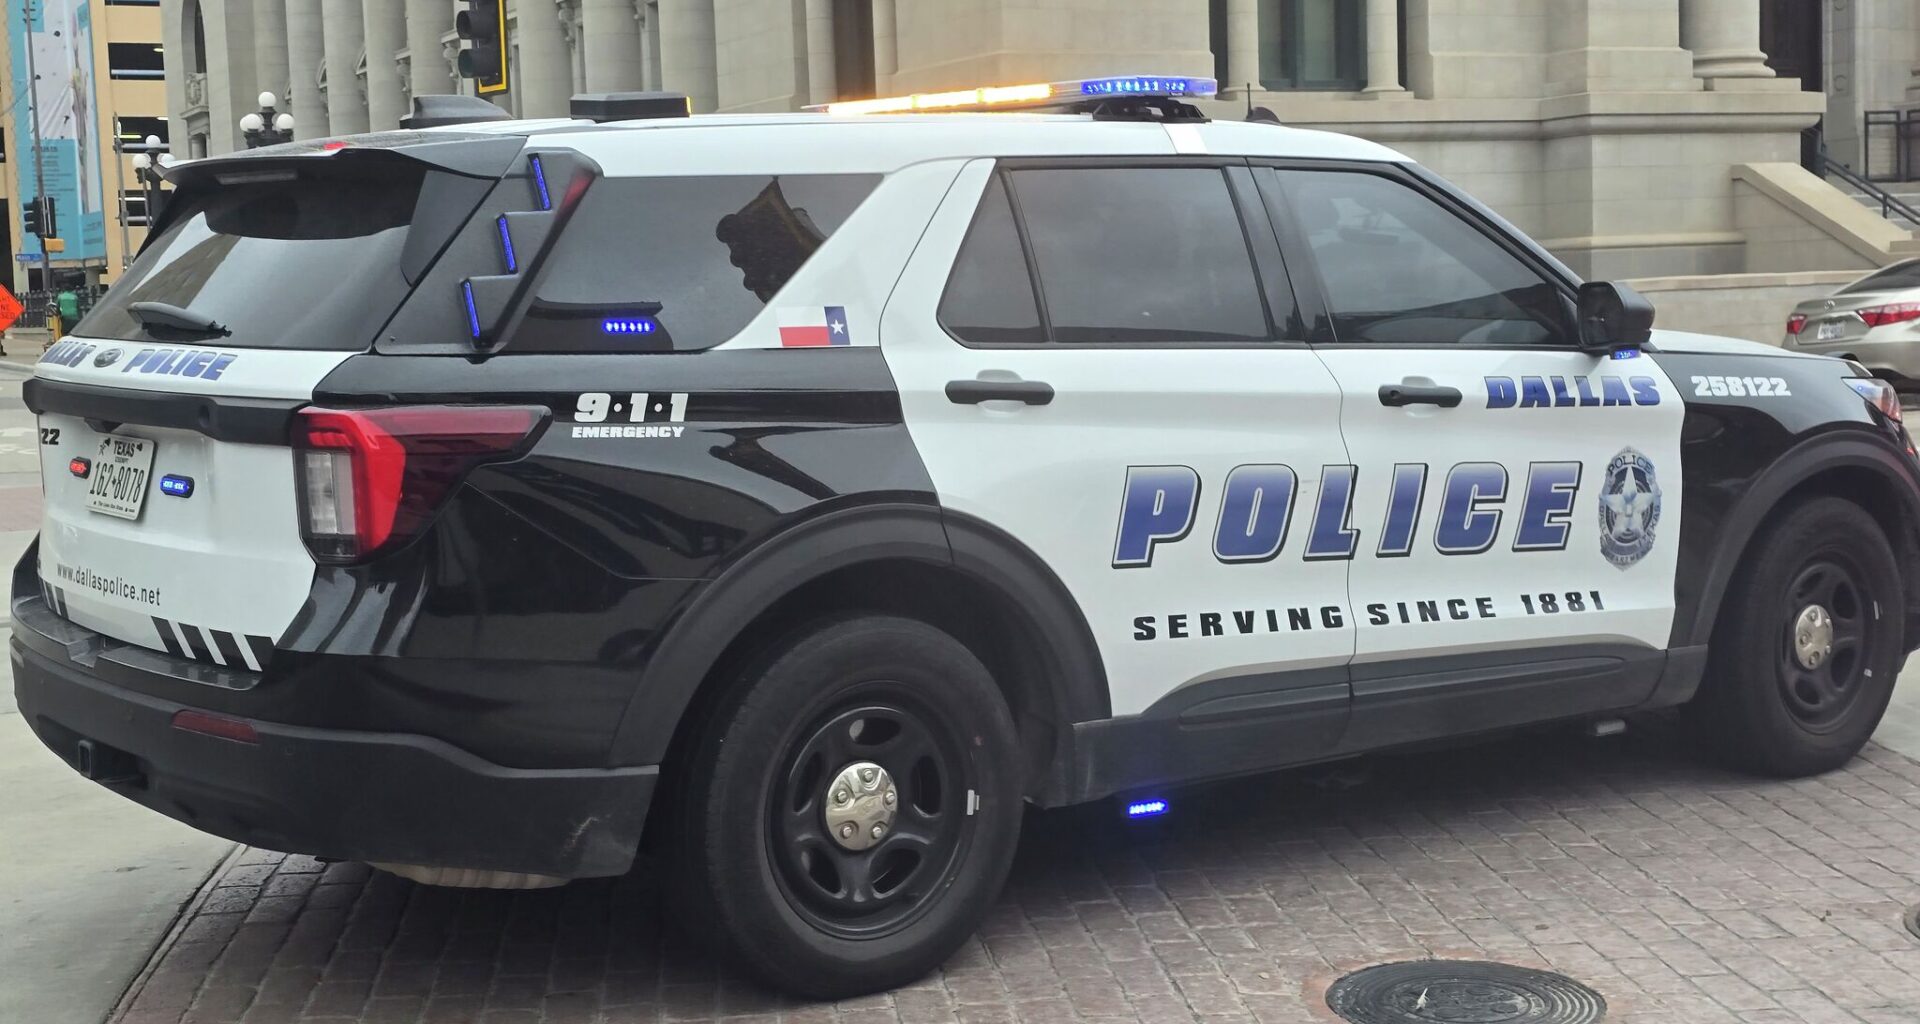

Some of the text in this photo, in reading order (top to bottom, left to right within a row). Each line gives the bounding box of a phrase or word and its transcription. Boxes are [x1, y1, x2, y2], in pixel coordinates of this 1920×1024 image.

[121, 348, 238, 381] POLICE
[1484, 376, 1661, 409] DALLAS
[1691, 375, 1792, 397] 258122
[41, 428, 60, 445] 22
[571, 426, 685, 438] EMERGENCY
[113, 440, 136, 457] TEXAS
[1607, 454, 1654, 475] POLICE
[1111, 461, 1583, 569] POLICE
[57, 563, 161, 606] www.dallaspolice.net
[1133, 590, 1605, 641] SERVING SINCE 1881
